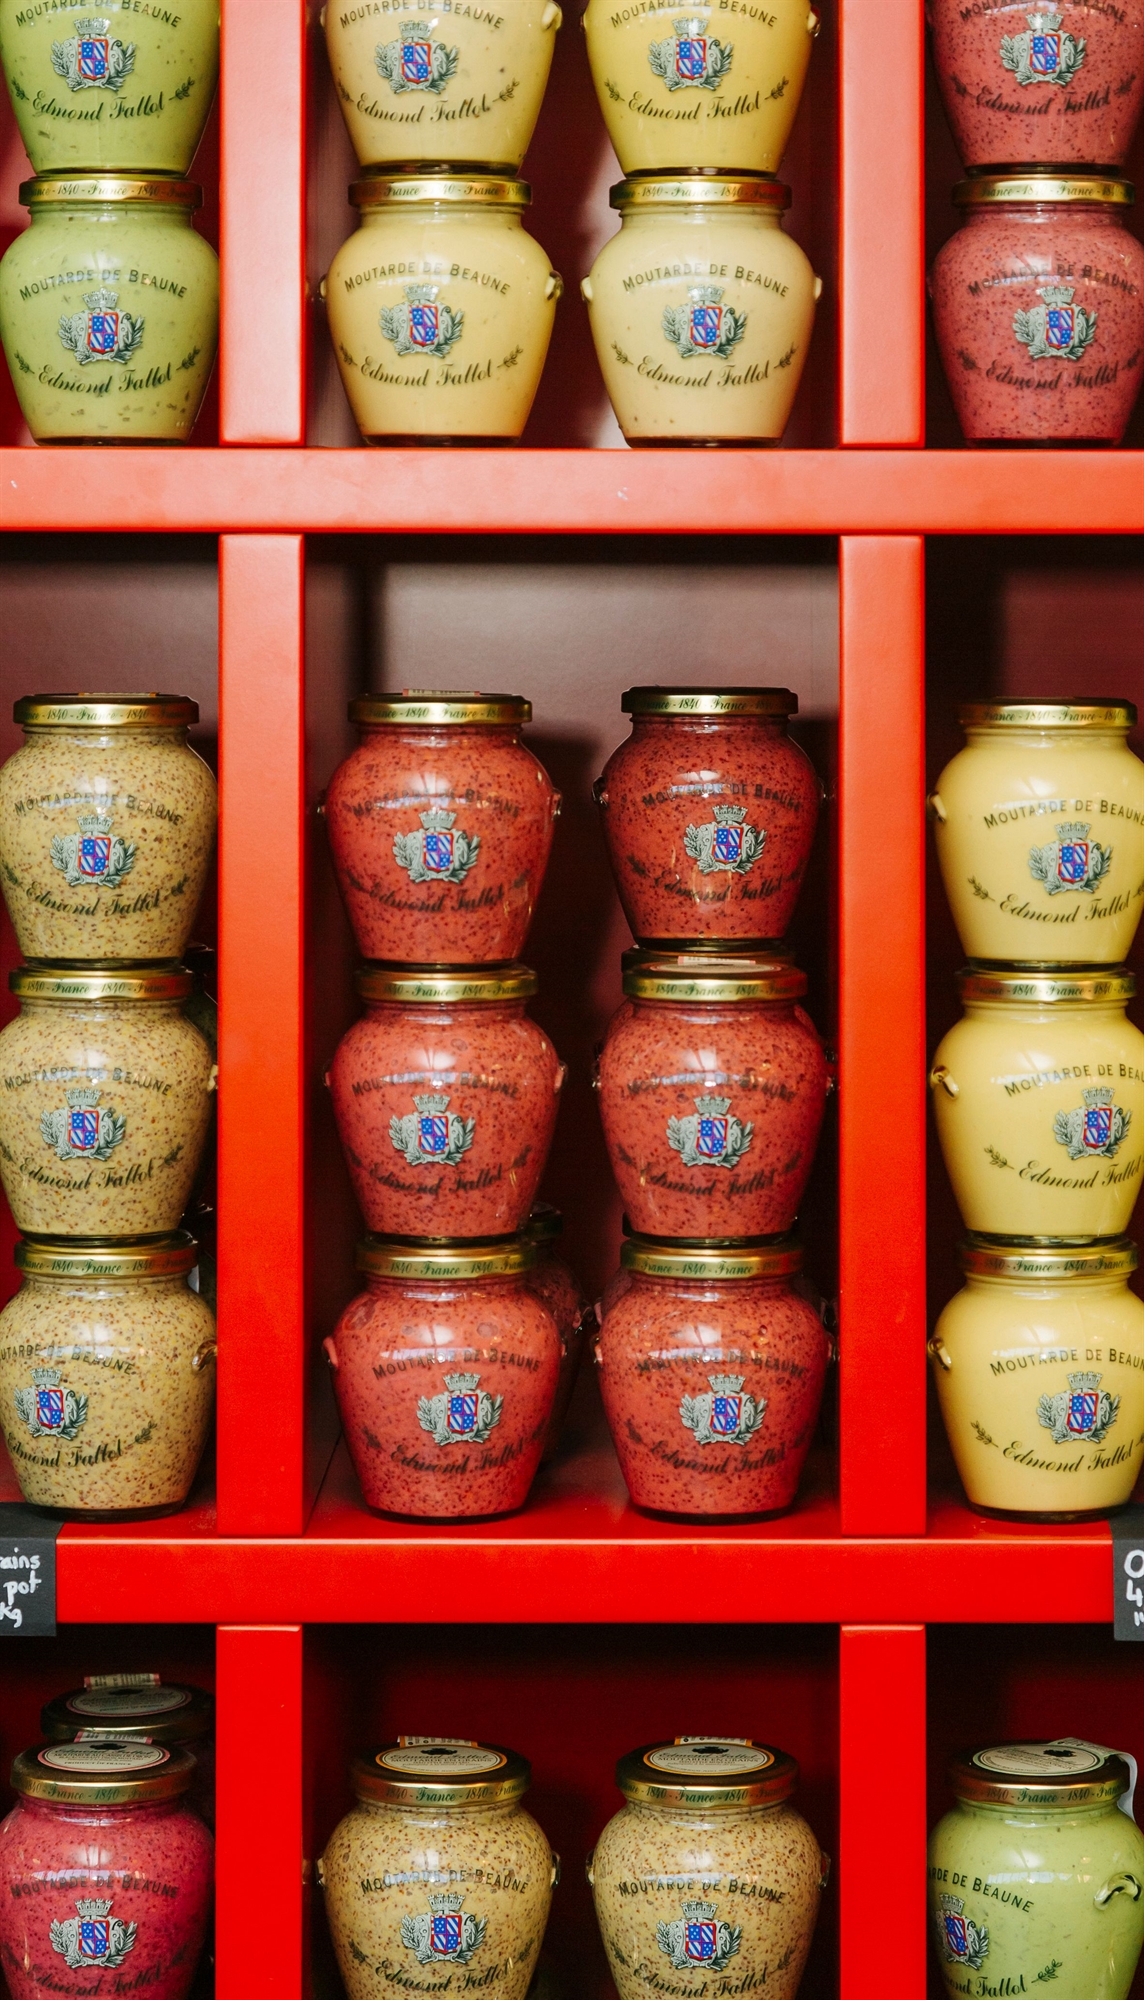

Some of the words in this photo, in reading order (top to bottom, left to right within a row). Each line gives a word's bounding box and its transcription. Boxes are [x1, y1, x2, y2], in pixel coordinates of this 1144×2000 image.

[121, 0, 181, 28] BEAUNE
[340, 0, 410, 28] MOUTARDE
[417, 0, 435, 10] DE
[443, 0, 505, 29] BEAUNE
[611, 0, 684, 28] MOUTARDE
[719, 0, 777, 27] BEAUNE
[32, 90, 104, 121] Edmond
[109, 91, 164, 120] Fallot
[357, 92, 424, 123] Edmond
[430, 93, 490, 122] Fallot
[629, 91, 701, 120] Edmond
[707, 91, 760, 119] Fallot
[1057, 86, 1111, 115] Fallot
[88, 181, 128, 196] France
[1057, 182, 1094, 197] France
[19, 269, 94, 301] MOUTARDE
[102, 269, 120, 281] DE
[129, 269, 187, 298] BEAUNE
[344, 261, 415, 292] MOUTARDE
[423, 262, 441, 274] DE
[450, 263, 511, 295] BEAUNE
[622, 263, 702, 291] MOUTARDE
[710, 264, 728, 276] DE
[735, 266, 789, 297] BEAUNE
[1057, 263, 1075, 276] DE
[1082, 264, 1138, 296] BEAUNE
[38, 364, 113, 394] Edmond
[118, 362, 172, 392] Fallot
[360, 356, 429, 387] Edmond
[435, 359, 491, 386] Fallot
[637, 355, 712, 388] Edmond
[717, 360, 770, 387] Fallot
[47, 708, 67, 720] 1840
[76, 706, 116, 721] France
[406, 707, 428, 718] 1840
[678, 698, 701, 709] 1840
[710, 694, 747, 711] France
[1058, 705, 1096, 722] France
[125, 794, 183, 826] BEAUNE
[984, 799, 1066, 830] MOUTARDE
[1075, 799, 1092, 812] DE
[26, 881, 100, 917] Edmond
[105, 889, 160, 917] Fallot
[999, 893, 1080, 923] Edmond
[1085, 890, 1131, 921] Fallot
[26, 981, 44, 993] 1840
[52, 979, 90, 994] France
[411, 982, 450, 996] France
[461, 982, 486, 996] 1840
[656, 982, 677, 994] 1840
[685, 981, 725, 996] France
[735, 982, 758, 995] 1840
[1013, 982, 1036, 996] 1840
[1046, 979, 1084, 996] France
[112, 1066, 172, 1096] BEAUNE
[1004, 1064, 1091, 1098] MOUTARDE
[1098, 1064, 1113, 1076] DE
[19, 1157, 93, 1191] Edmond
[98, 1160, 153, 1189] Fallot
[1019, 1159, 1099, 1189] Edmond
[1102, 1155, 1140, 1187] Fallot
[50, 1259, 73, 1273] 1840
[81, 1259, 123, 1274] France
[420, 1259, 460, 1277] France
[470, 1259, 494, 1273] 1840
[641, 1259, 672, 1274] France
[681, 1261, 706, 1274] 1840
[714, 1259, 753, 1276] France
[1012, 1256, 1053, 1273] France
[1063, 1258, 1087, 1271] 1840
[1094, 1256, 1124, 1269] France
[71, 1346, 135, 1376] BEAUNE
[463, 1349, 481, 1363] DE
[489, 1348, 541, 1372] BEAUNE
[990, 1349, 1078, 1377] MOUTARDE
[1086, 1349, 1103, 1362] DE
[67, 1439, 122, 1467] Fallot
[1002, 1440, 1083, 1473] Edmond
[1087, 1439, 1134, 1471] Fallot
[0, 1547, 40, 1569] ains
[3, 1570, 42, 1606] pot
[44, 1782, 85, 1801] France
[94, 1786, 119, 1801] 1840
[415, 1786, 456, 1802] France
[466, 1788, 489, 1800] 1840
[646, 1786, 666, 1799] 1840
[675, 1785, 715, 1803] France
[724, 1787, 748, 1801] 1840
[1017, 1787, 1057, 1804] France
[1067, 1787, 1090, 1801] 1840
[122, 1874, 179, 1900] BEAUNE
[448, 1869, 469, 1882] DE
[475, 1869, 529, 1895] BEAUNE
[618, 1878, 695, 1897] MOUTARDE
[702, 1879, 722, 1892] DE
[728, 1879, 786, 1904] BEAUNE
[952, 1872, 968, 1888] DE
[972, 1877, 1035, 1914] BEAUNE
[375, 1959, 451, 1993] Edmond
[633, 1962, 707, 1998] Edmond
[712, 1968, 768, 1996] Fallot
[976, 1974, 1028, 1998] Fallot
